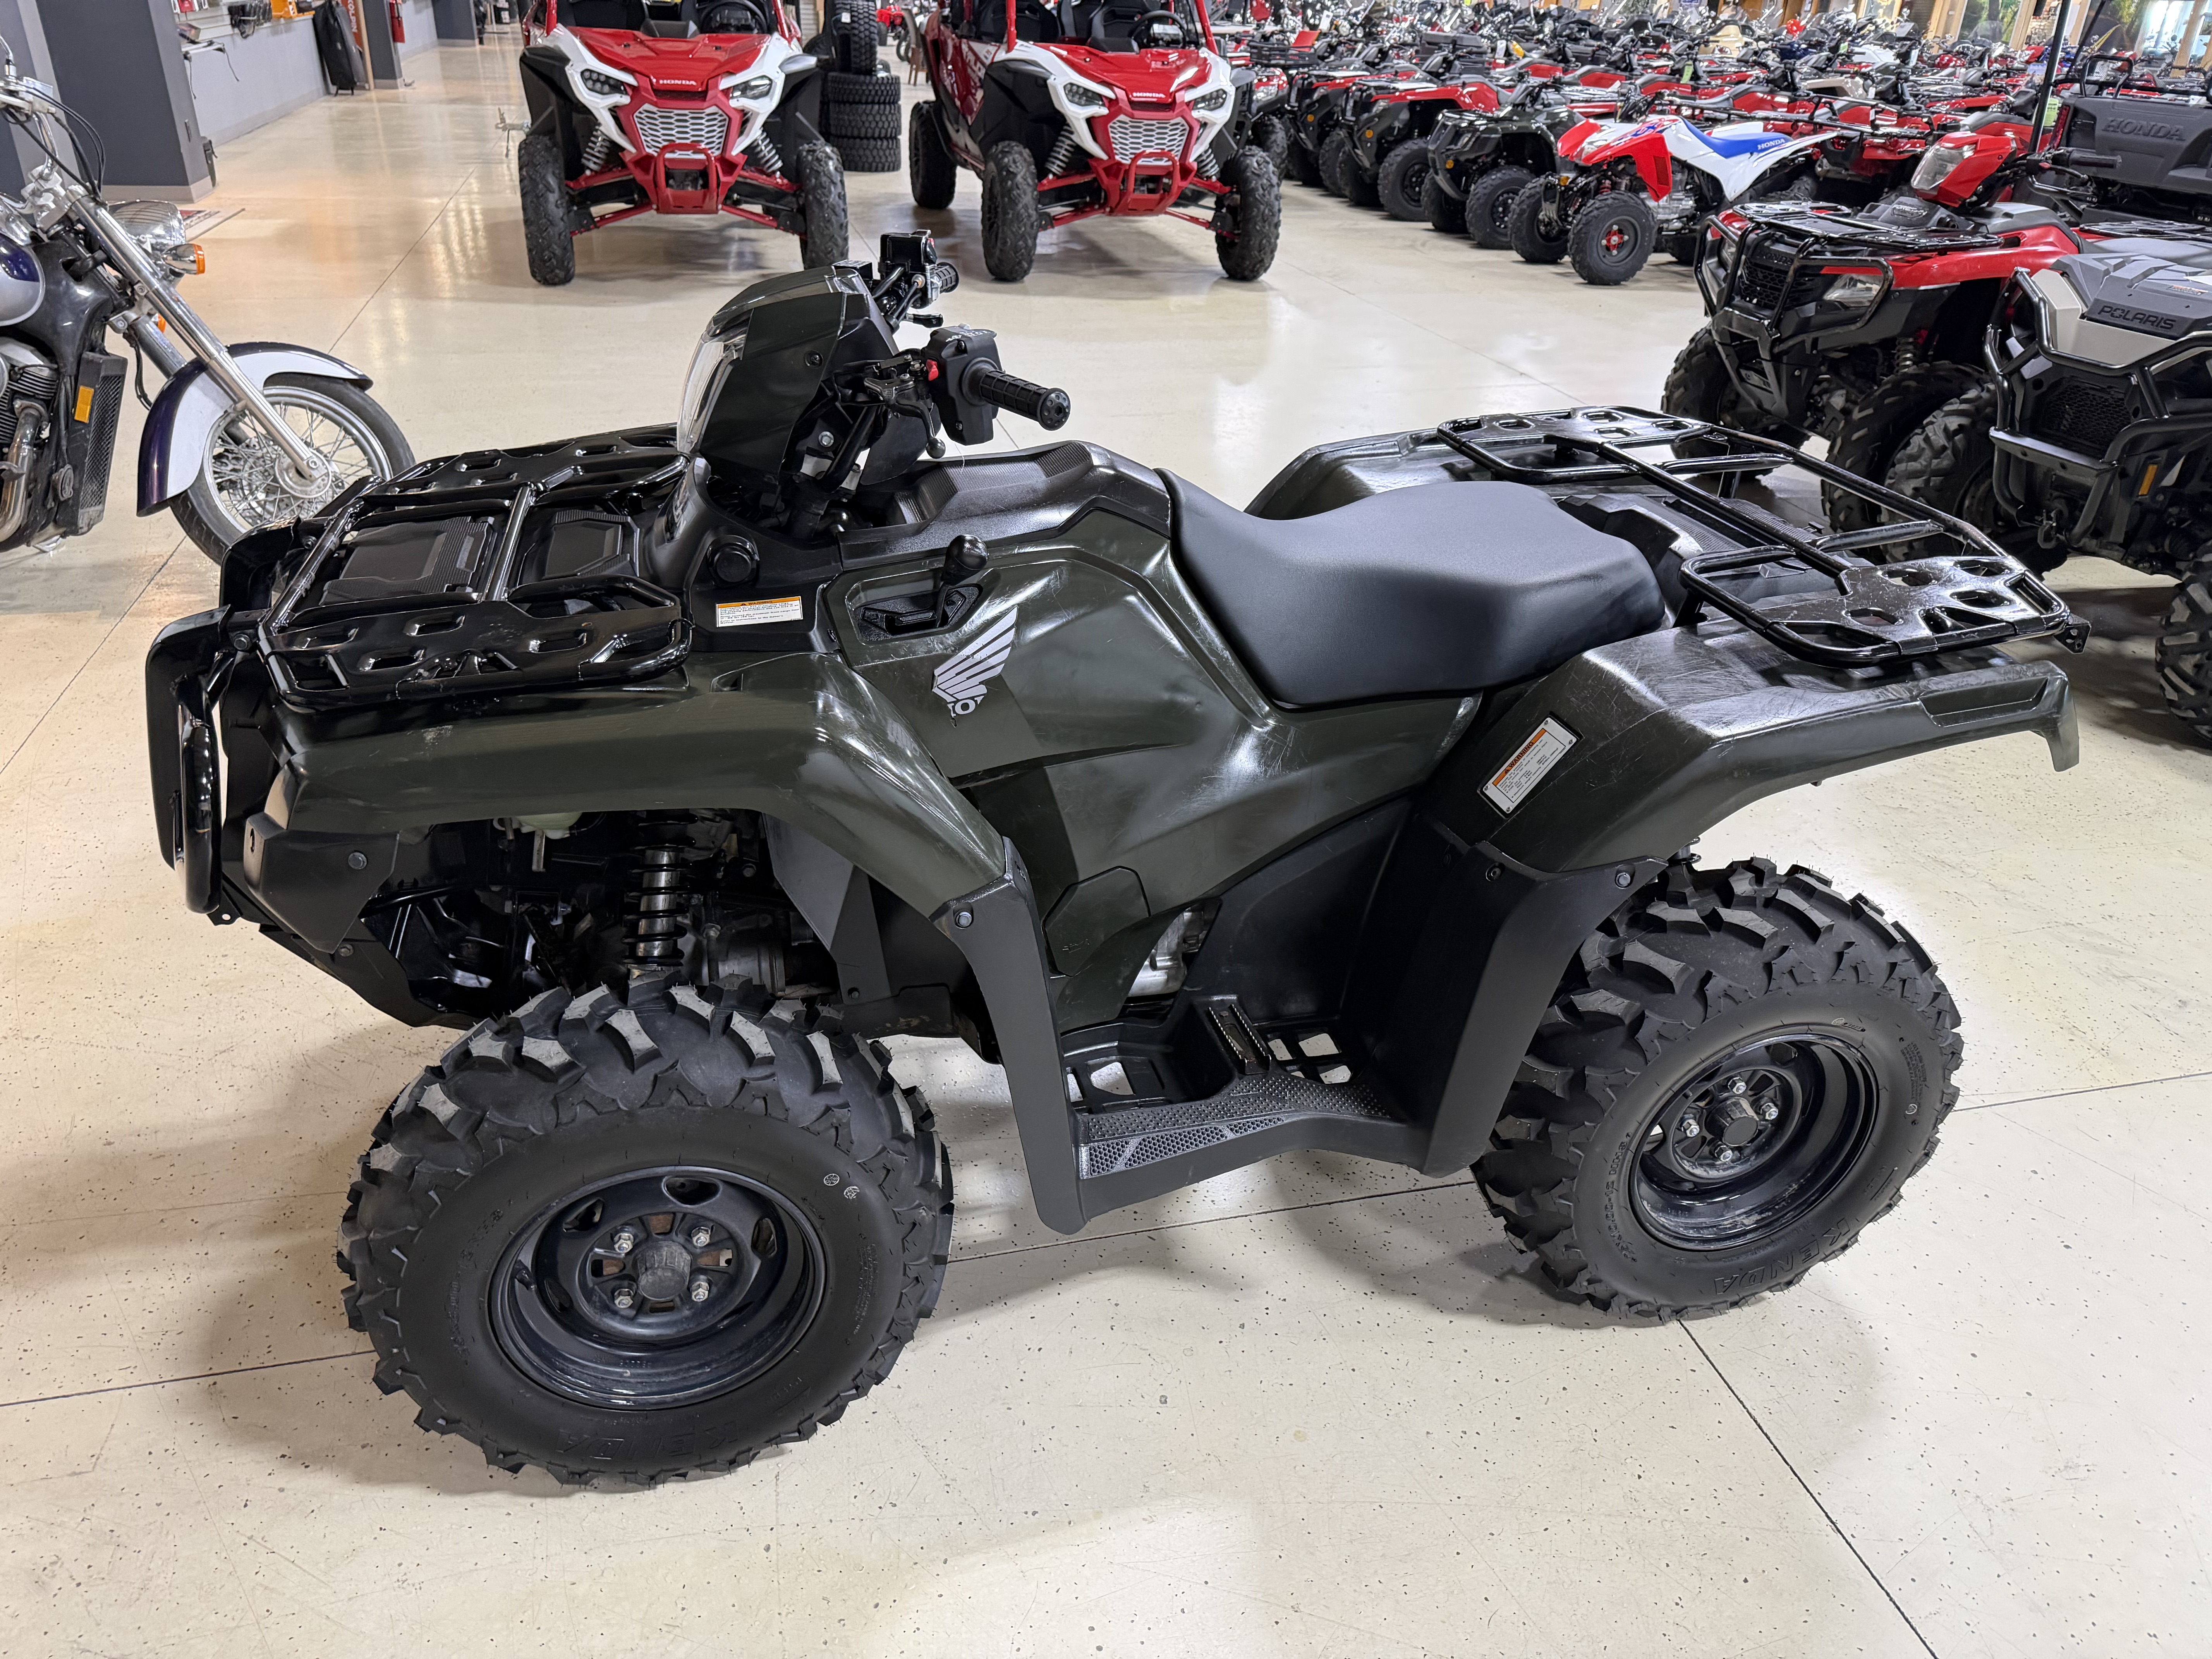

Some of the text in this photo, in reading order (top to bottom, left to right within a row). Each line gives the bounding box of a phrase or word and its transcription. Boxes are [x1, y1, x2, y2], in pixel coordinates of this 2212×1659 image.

[2102, 117, 2186, 141] HONDA
[1757, 138, 1785, 150] HONDA
[2098, 305, 2176, 330] POLARIS
[1508, 742, 1534, 768] WARNING
[1714, 1217, 1850, 1295] KENDA
